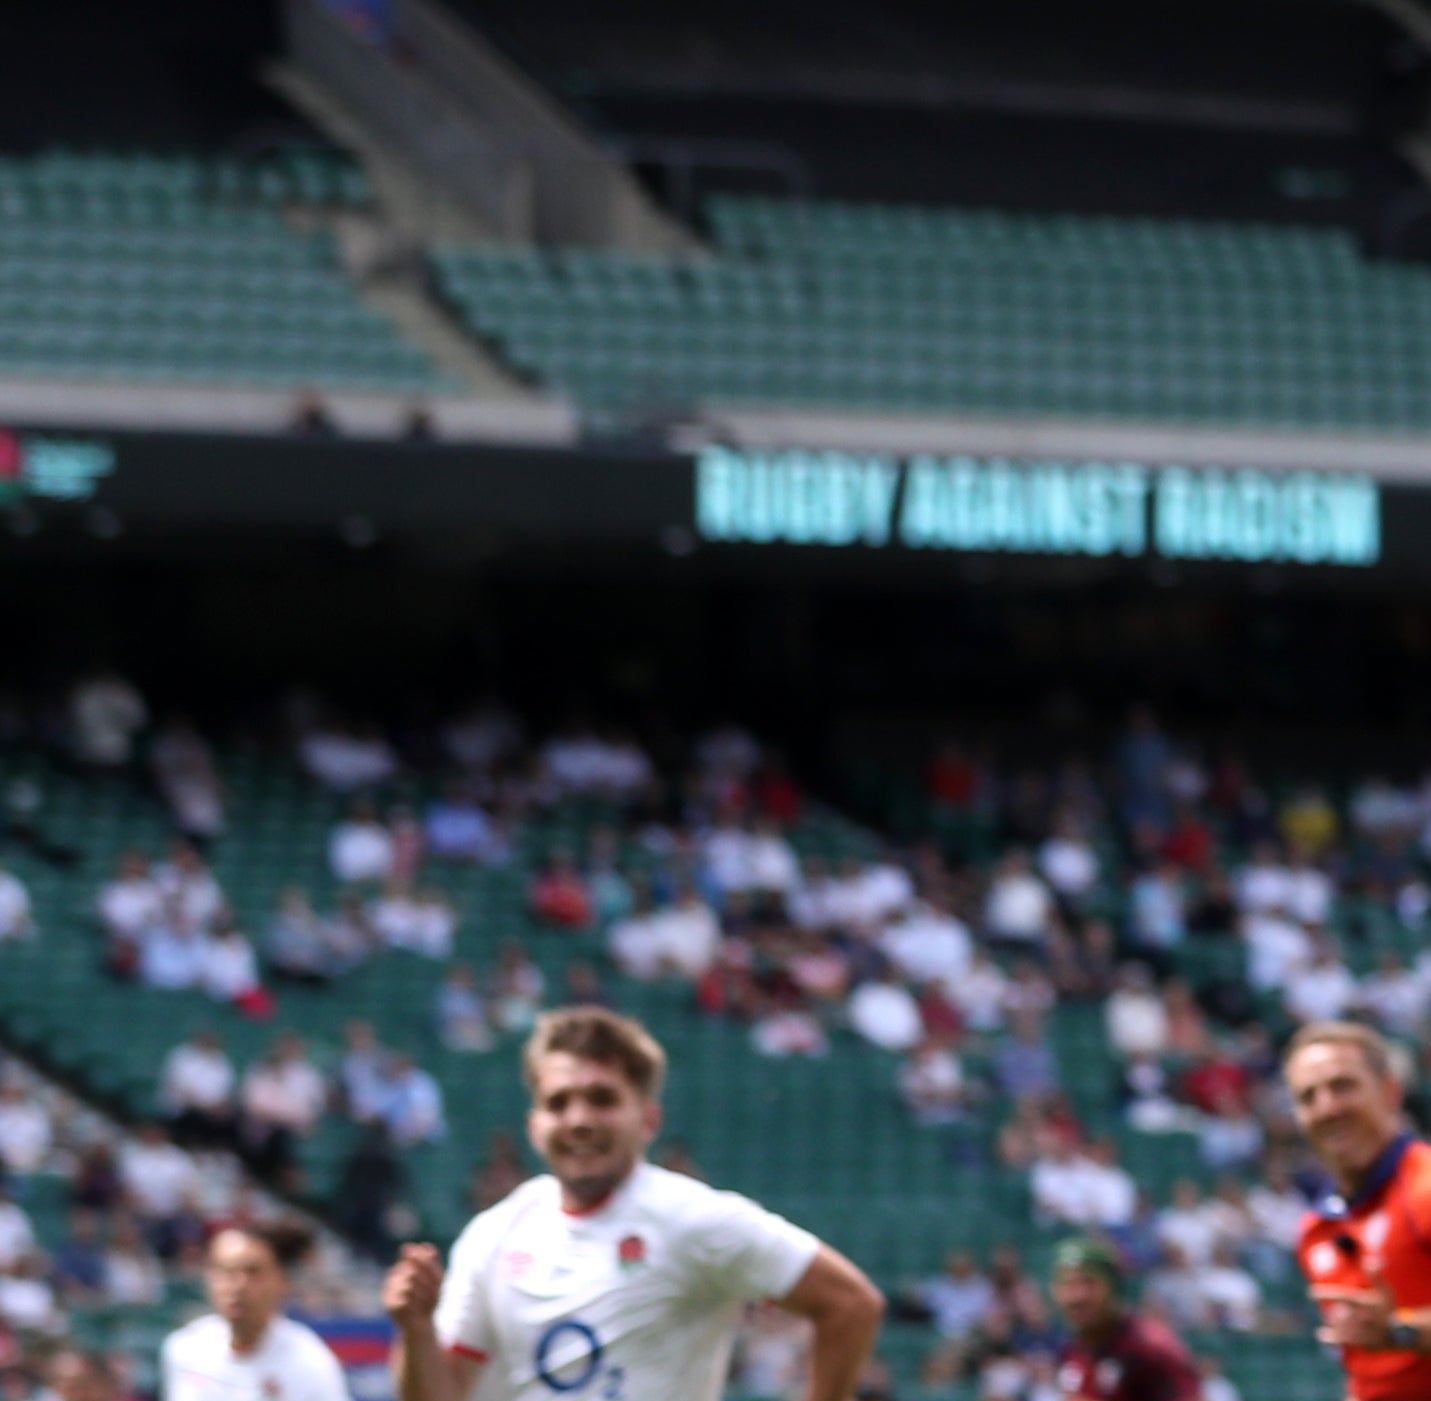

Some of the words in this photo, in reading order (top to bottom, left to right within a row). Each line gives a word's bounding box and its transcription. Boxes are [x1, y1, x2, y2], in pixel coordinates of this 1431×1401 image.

[697, 447, 896, 544] RUGBY
[902, 454, 1149, 556] AGAINST
[1154, 464, 1380, 565] RACISM
